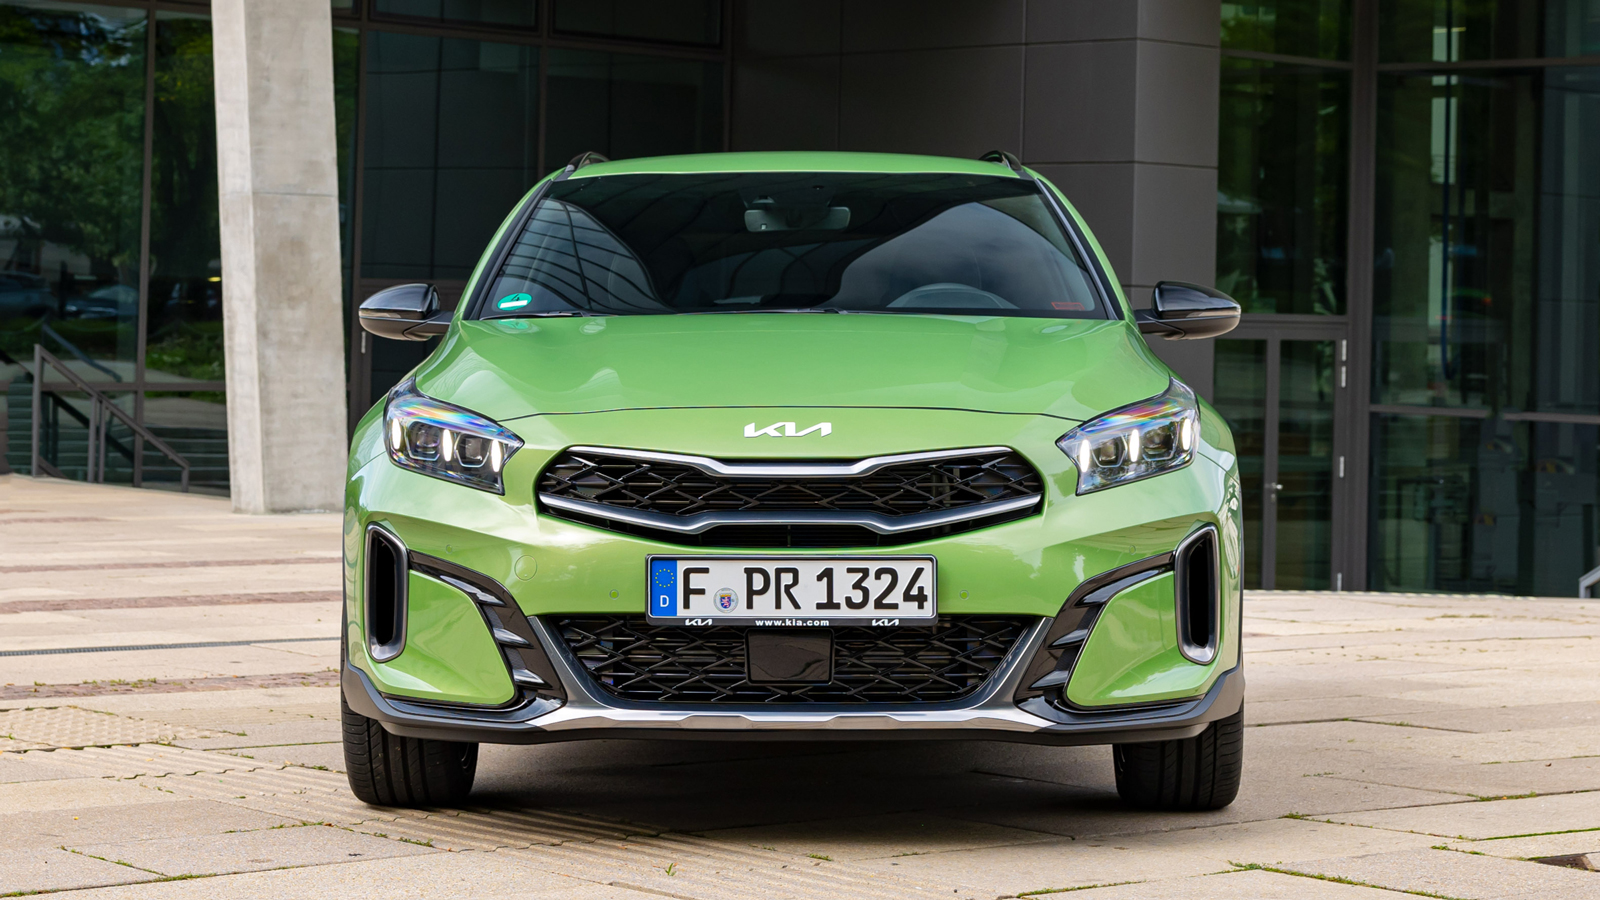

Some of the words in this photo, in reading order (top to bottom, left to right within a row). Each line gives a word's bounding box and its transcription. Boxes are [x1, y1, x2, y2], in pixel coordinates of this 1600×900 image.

[744, 421, 832, 438] KIA
[682, 567, 710, 610] F
[743, 567, 801, 610] PR
[815, 567, 928, 610] 1324
[660, 595, 669, 607] D
[685, 618, 713, 626] KIA
[755, 618, 830, 627] www.kia.com
[871, 618, 900, 627] KIA
